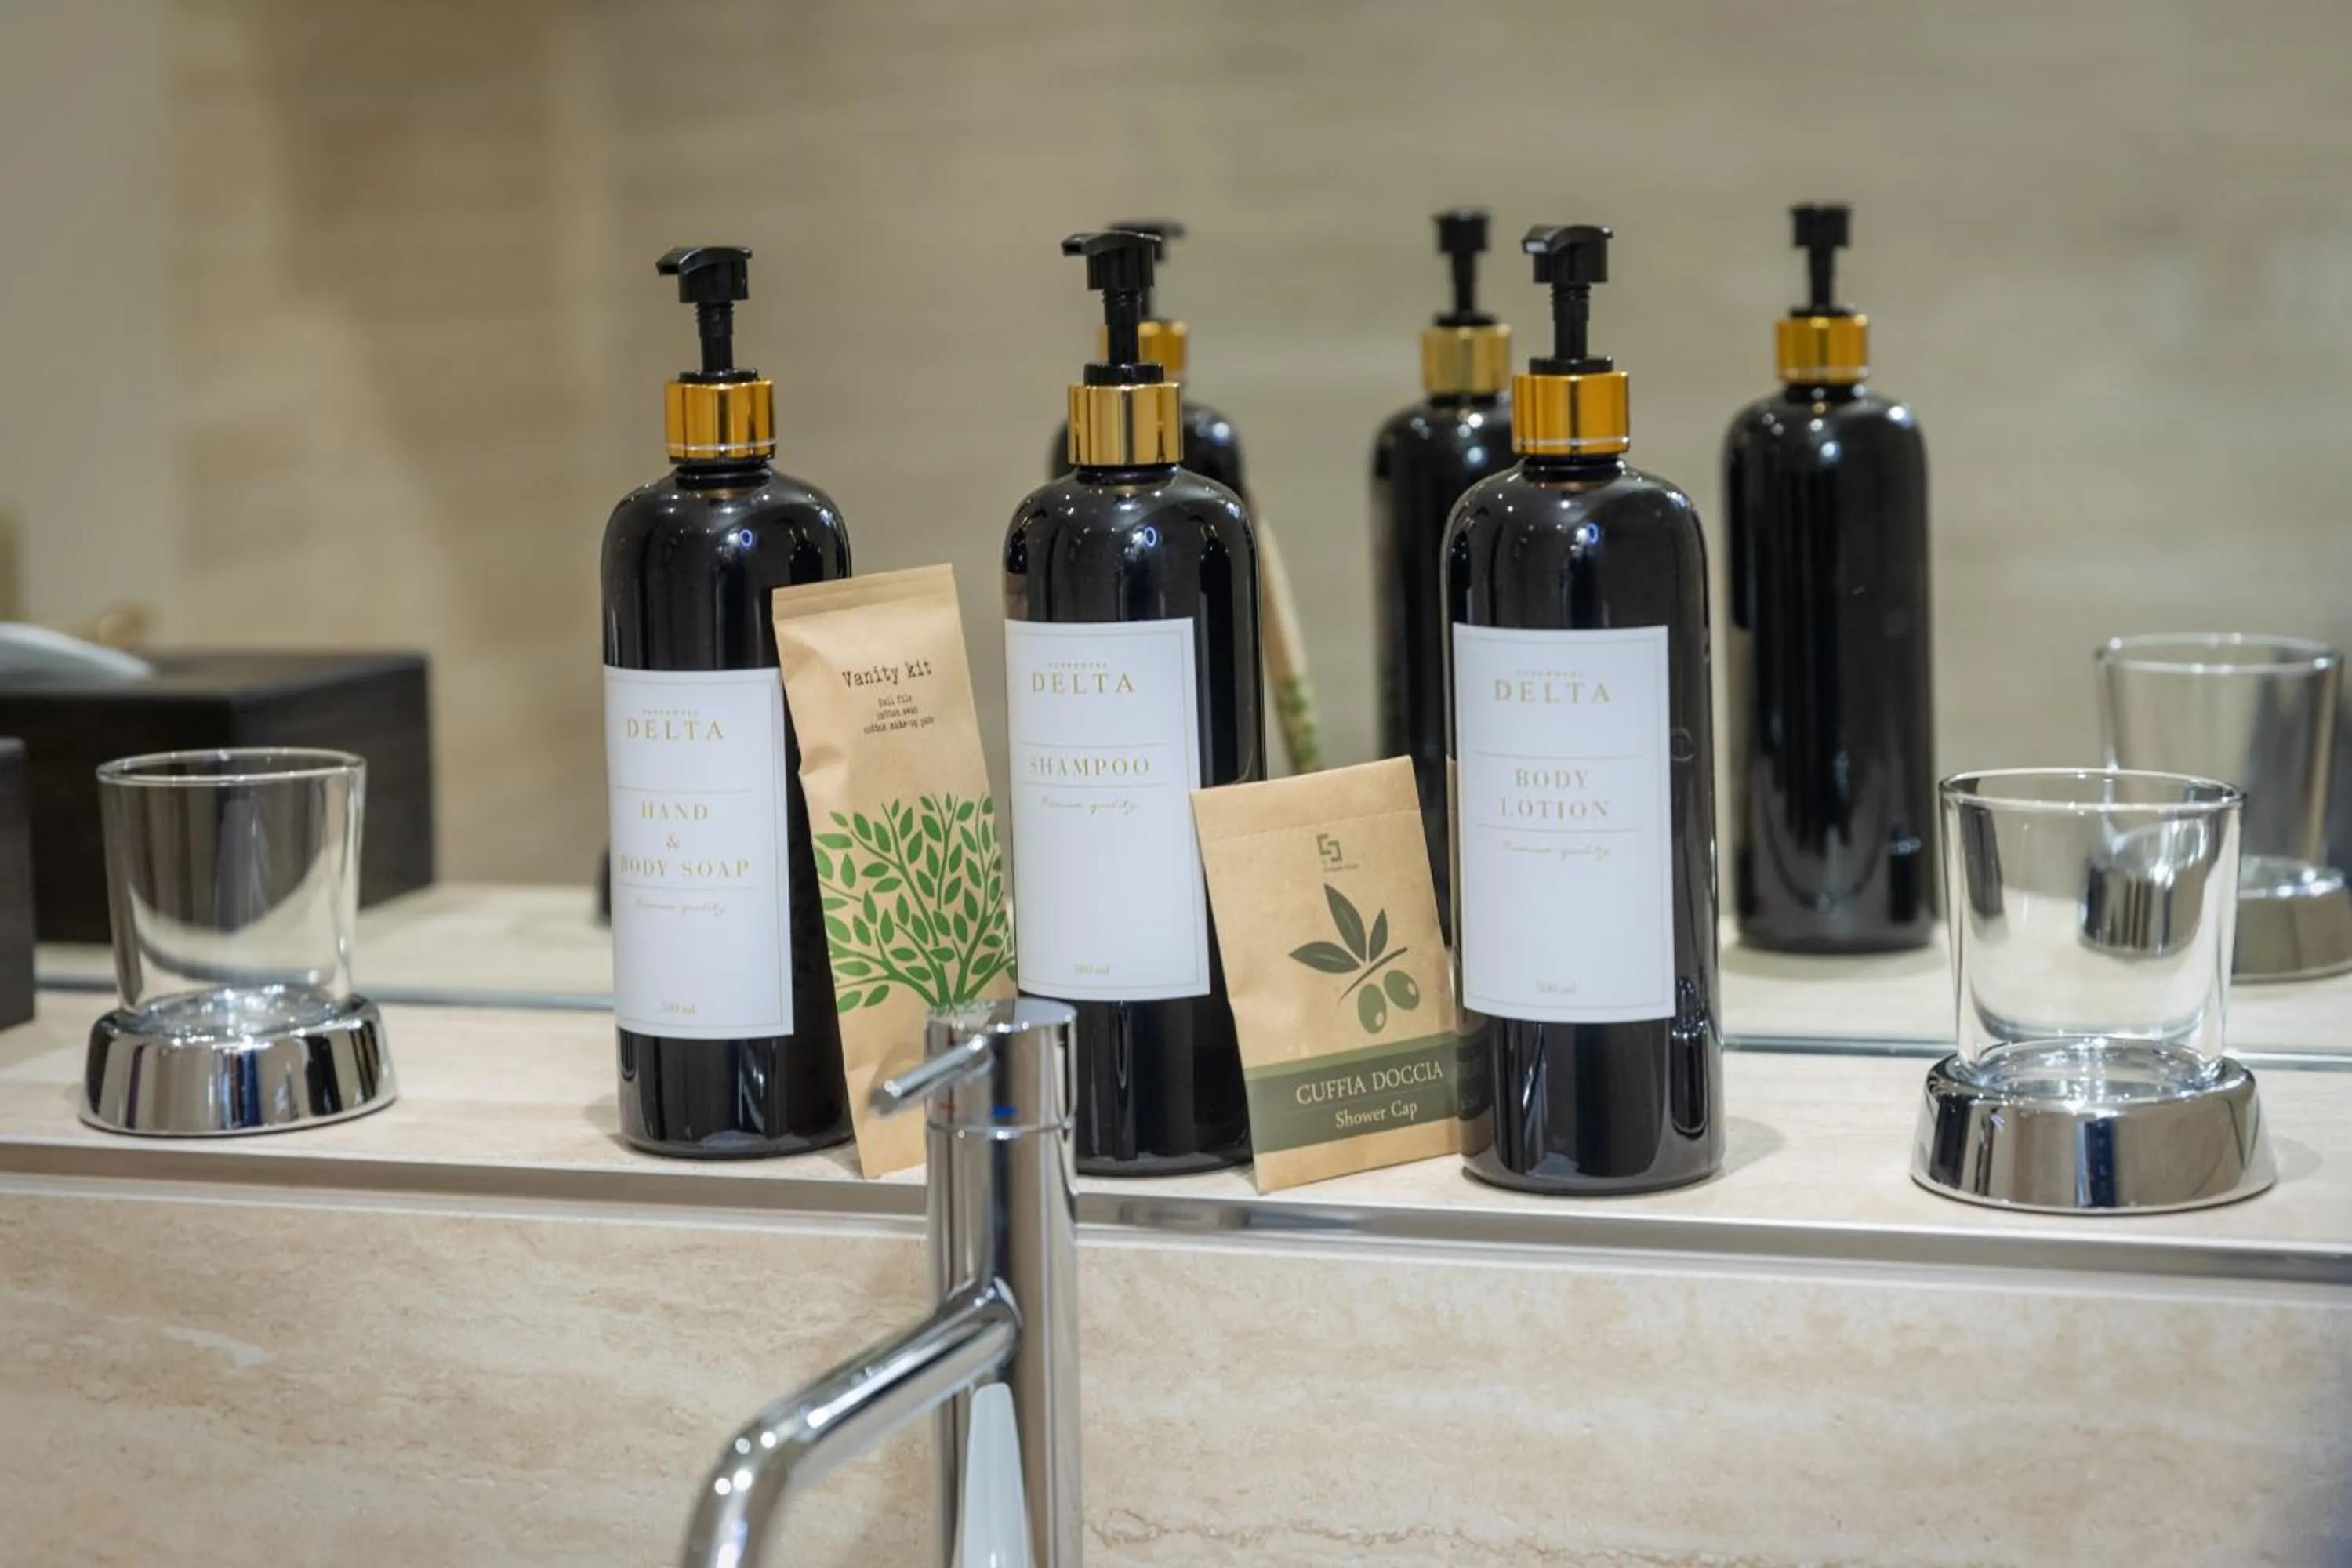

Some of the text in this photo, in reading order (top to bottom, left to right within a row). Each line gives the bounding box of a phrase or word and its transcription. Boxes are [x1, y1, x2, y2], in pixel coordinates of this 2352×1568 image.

[841, 659, 932, 688] Vanity kit
[1031, 671, 1134, 694] DELTA
[1494, 679, 1610, 703] DELTA
[626, 718, 725, 740] DELTA
[1029, 757, 1149, 777] SHAMPOO
[1516, 768, 1589, 789] BODY
[641, 800, 709, 820] HAND
[1499, 797, 1610, 819] LOTION
[666, 834, 681, 850] &
[620, 855, 750, 878] BODY SOAP
[1295, 1060, 1444, 1105] CUFFIA DOCCIA
[1335, 1100, 1418, 1129] Shower Cap
